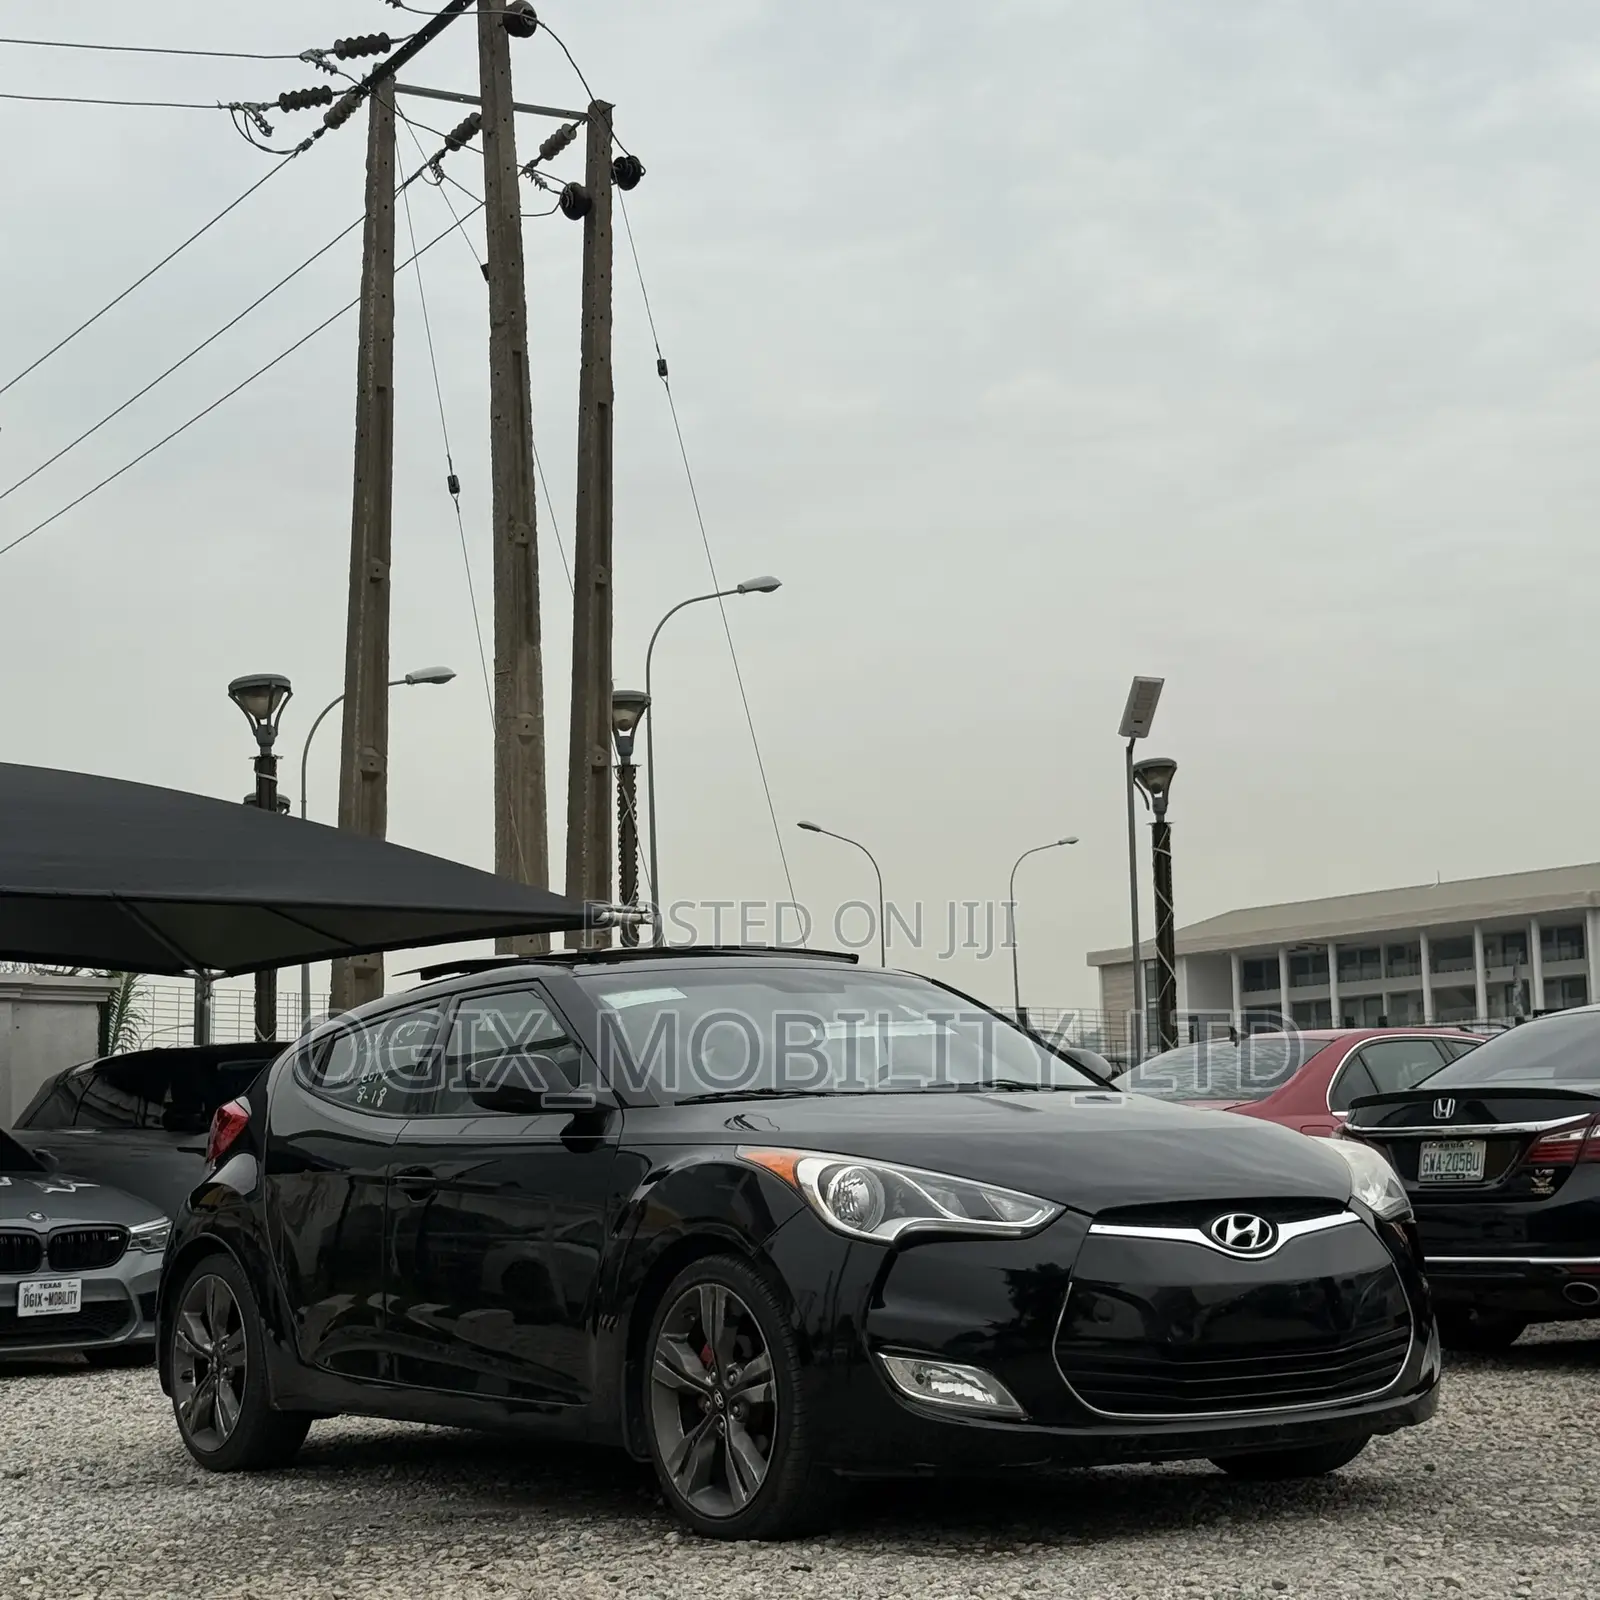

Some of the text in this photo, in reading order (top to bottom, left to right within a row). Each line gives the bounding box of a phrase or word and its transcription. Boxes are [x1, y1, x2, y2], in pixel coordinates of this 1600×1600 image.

[1423, 1152, 1480, 1172] GWA-205BU
[23, 1290, 78, 1308] OGIX MOBILITY
